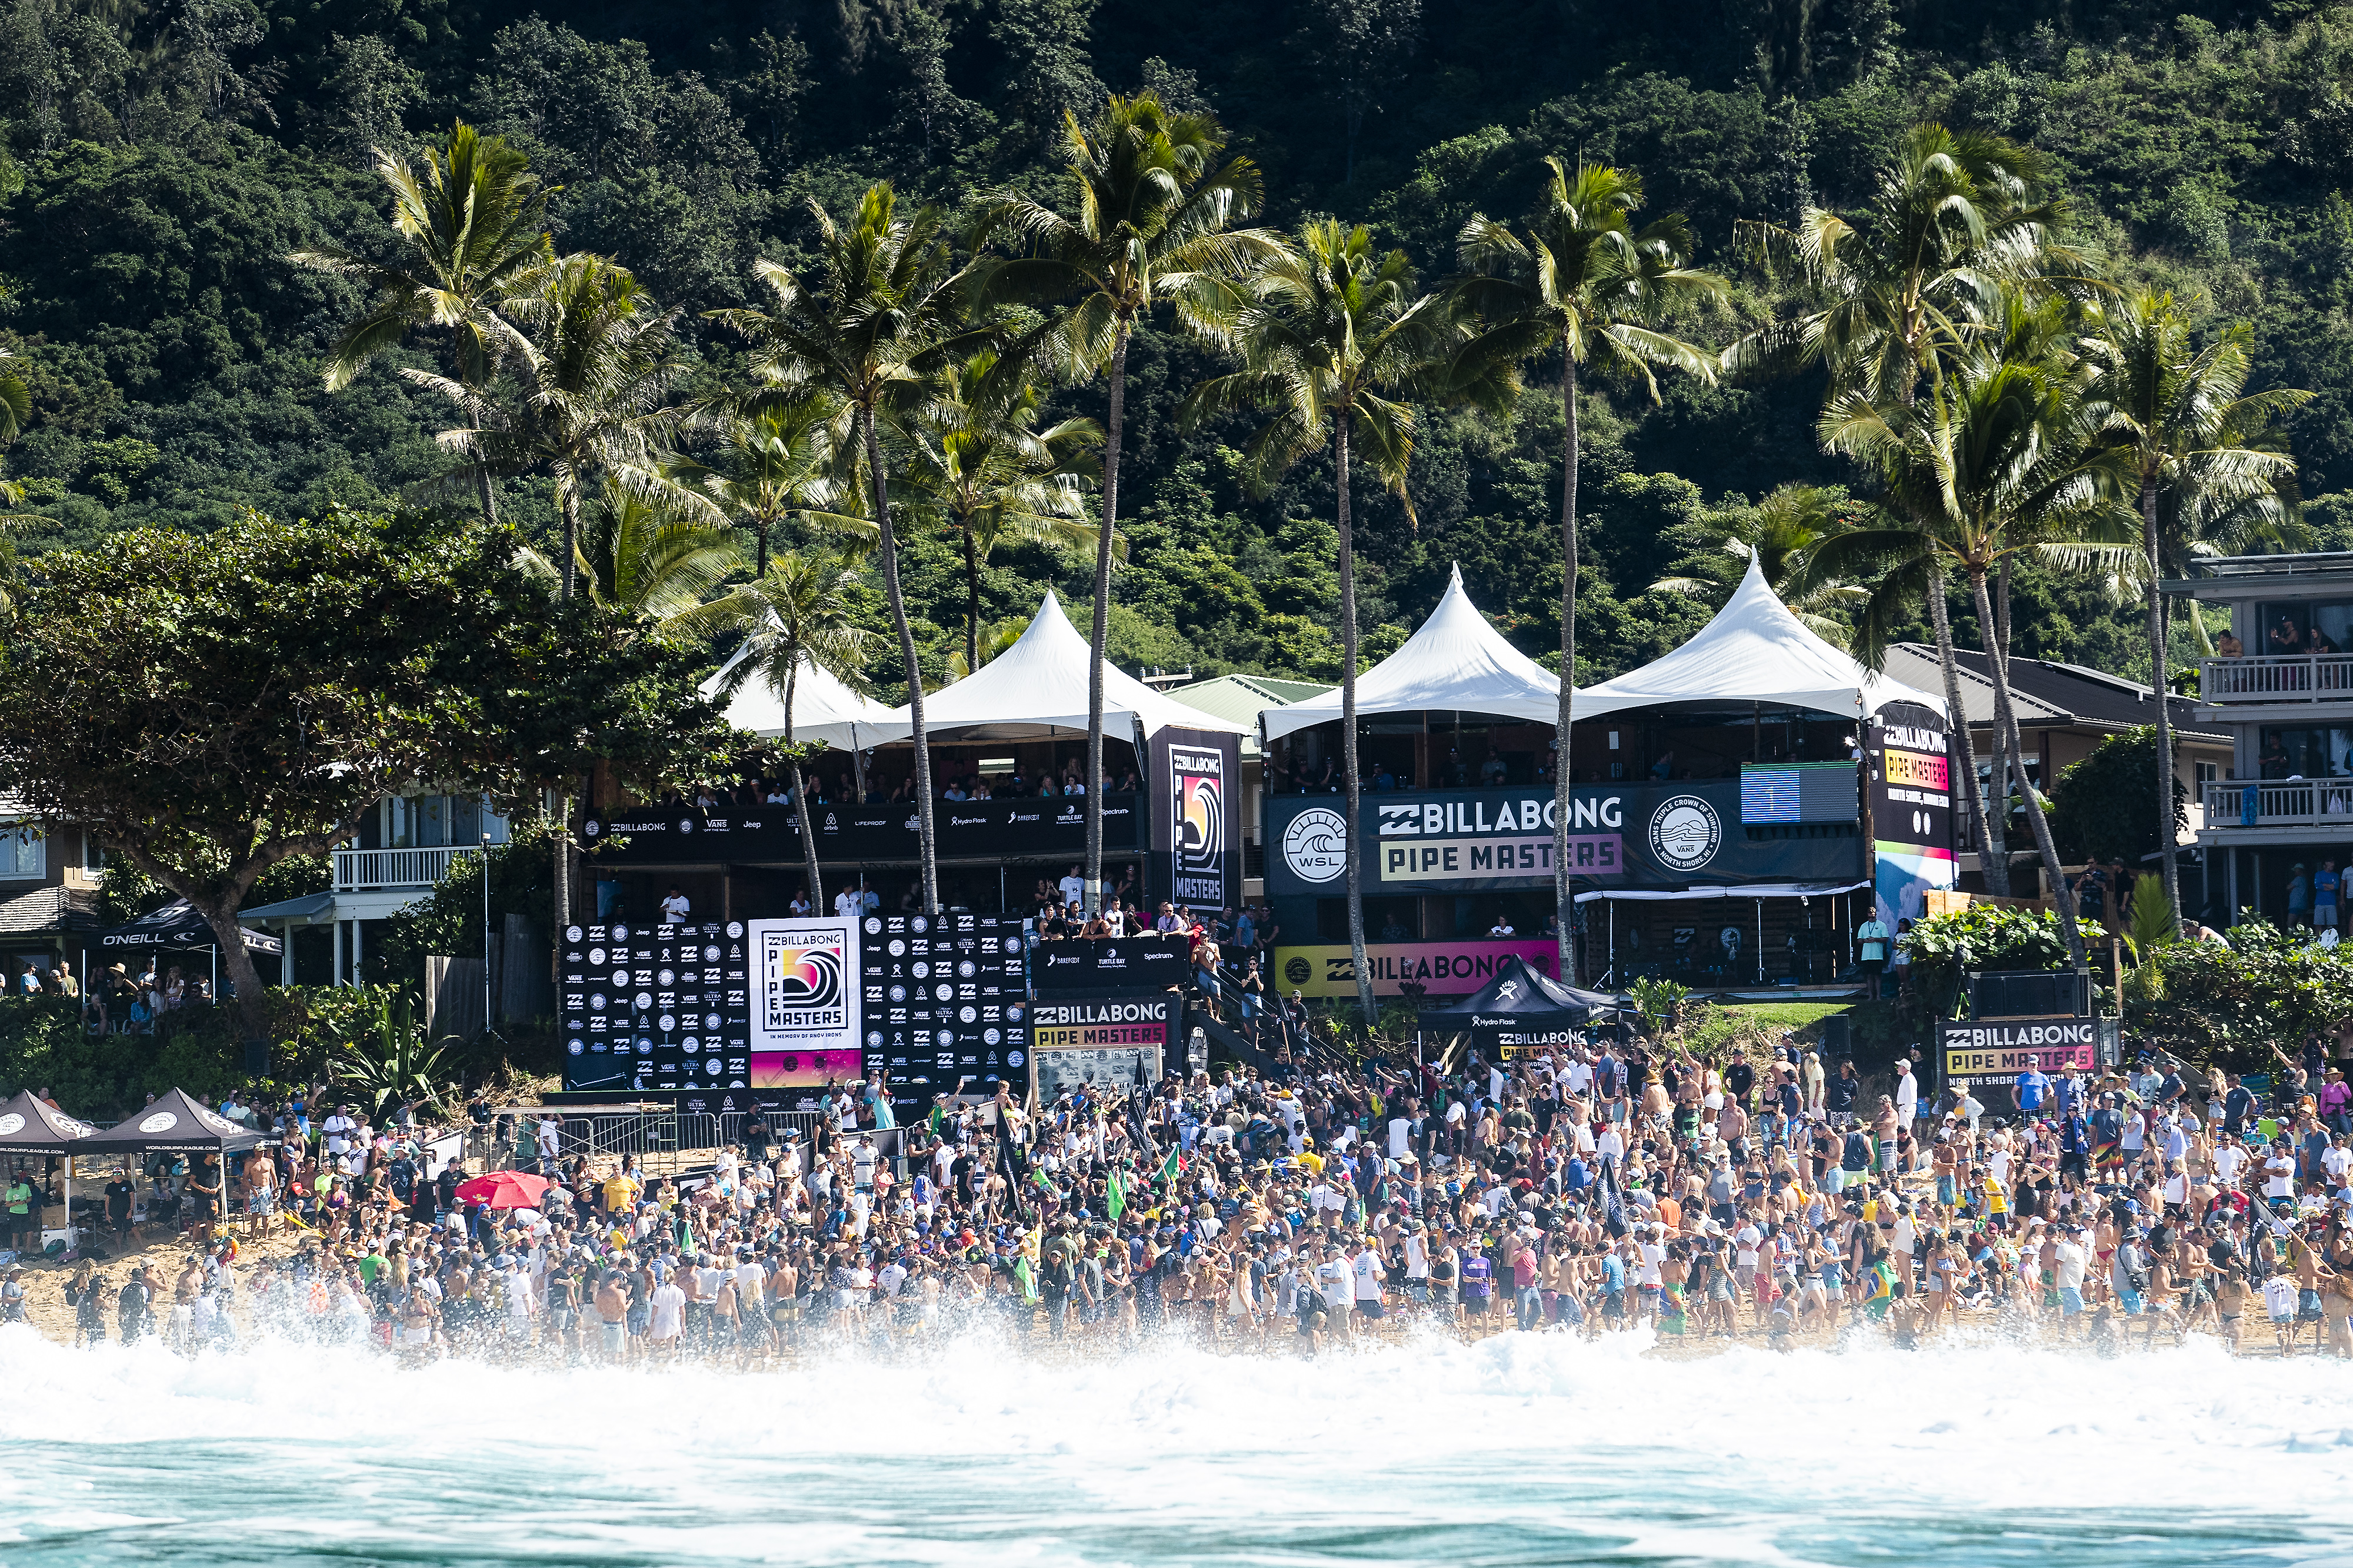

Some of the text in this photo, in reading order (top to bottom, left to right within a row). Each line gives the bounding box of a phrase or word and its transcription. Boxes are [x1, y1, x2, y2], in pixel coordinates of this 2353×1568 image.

[1182, 755, 1219, 773] BILLABONG
[1889, 757, 1909, 778] PIPE
[706, 819, 727, 828] VANS
[1424, 796, 1622, 833] BILLABONG
[1654, 803, 1674, 824] TRIPLE
[1674, 799, 1699, 808] CROWN
[1699, 805, 1709, 813] OF
[1706, 812, 1718, 843] SURFING
[621, 823, 666, 831] BILLABONG
[743, 821, 761, 829] Jeep
[1299, 856, 1340, 868] WSL
[1389, 846, 1458, 873] PIPE
[1660, 849, 1711, 868] NORTH SHORE, HI
[1176, 878, 1221, 900] MASTERS
[104, 933, 165, 945] O'NEILL
[782, 935, 840, 946] BILLABONG
[769, 950, 778, 1010] PIPE
[769, 1010, 842, 1026] MASTERS
[1058, 1003, 1166, 1023] BILLABONG
[1039, 1027, 1162, 1045] PIPE MASTERS
[1515, 1030, 1586, 1045] BILLABONG
[1972, 1025, 2094, 1046] BILLABONG
[1952, 1053, 1995, 1069] PIPE
